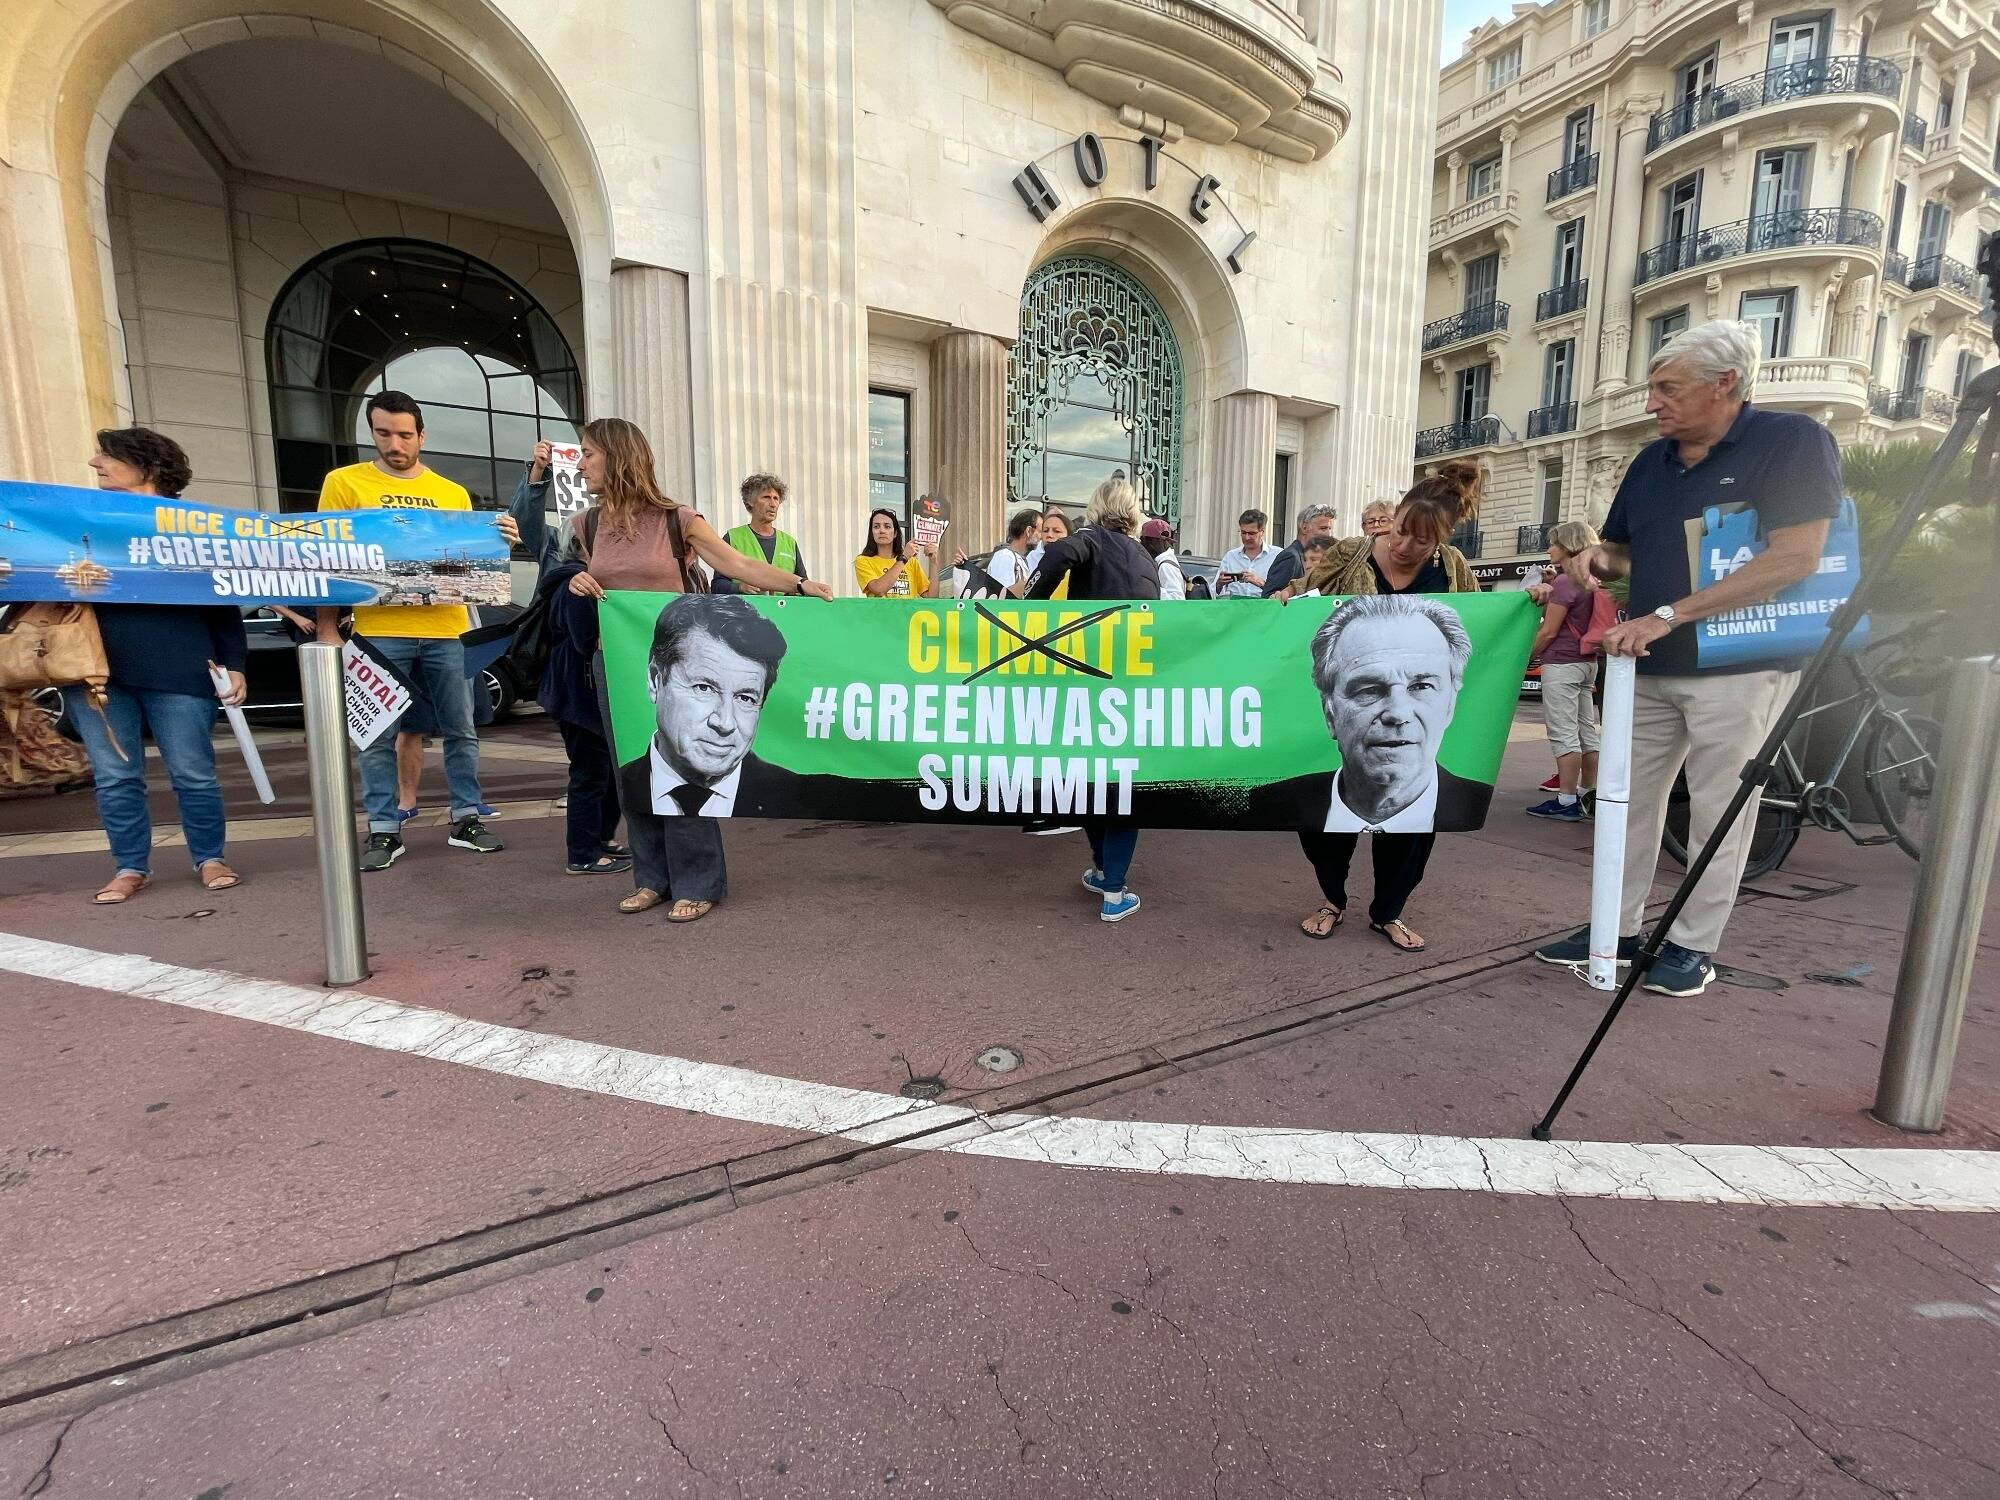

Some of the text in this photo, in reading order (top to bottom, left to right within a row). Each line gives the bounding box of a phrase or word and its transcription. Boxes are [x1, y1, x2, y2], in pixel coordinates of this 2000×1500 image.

[1012, 131, 1258, 274] HOTEL
[394, 495, 439, 508] TOTAL
[155, 506, 355, 541] NICE CLIMATE
[917, 520, 941, 532] CLIMATE
[918, 532, 938, 542] KILLER
[128, 536, 386, 571] #GREENWASHING
[212, 568, 331, 598] SUMMIT
[907, 609, 1155, 677] CLIMATE
[1706, 618, 1777, 637] SUMMIT
[345, 675, 381, 717] SPONSOR
[347, 654, 398, 713] TOTAL
[347, 695, 374, 727] CHAOS
[347, 710, 369, 738] TIQUE
[804, 683, 1263, 749] #GREENWASHING
[918, 753, 1139, 815] SUMMIT
